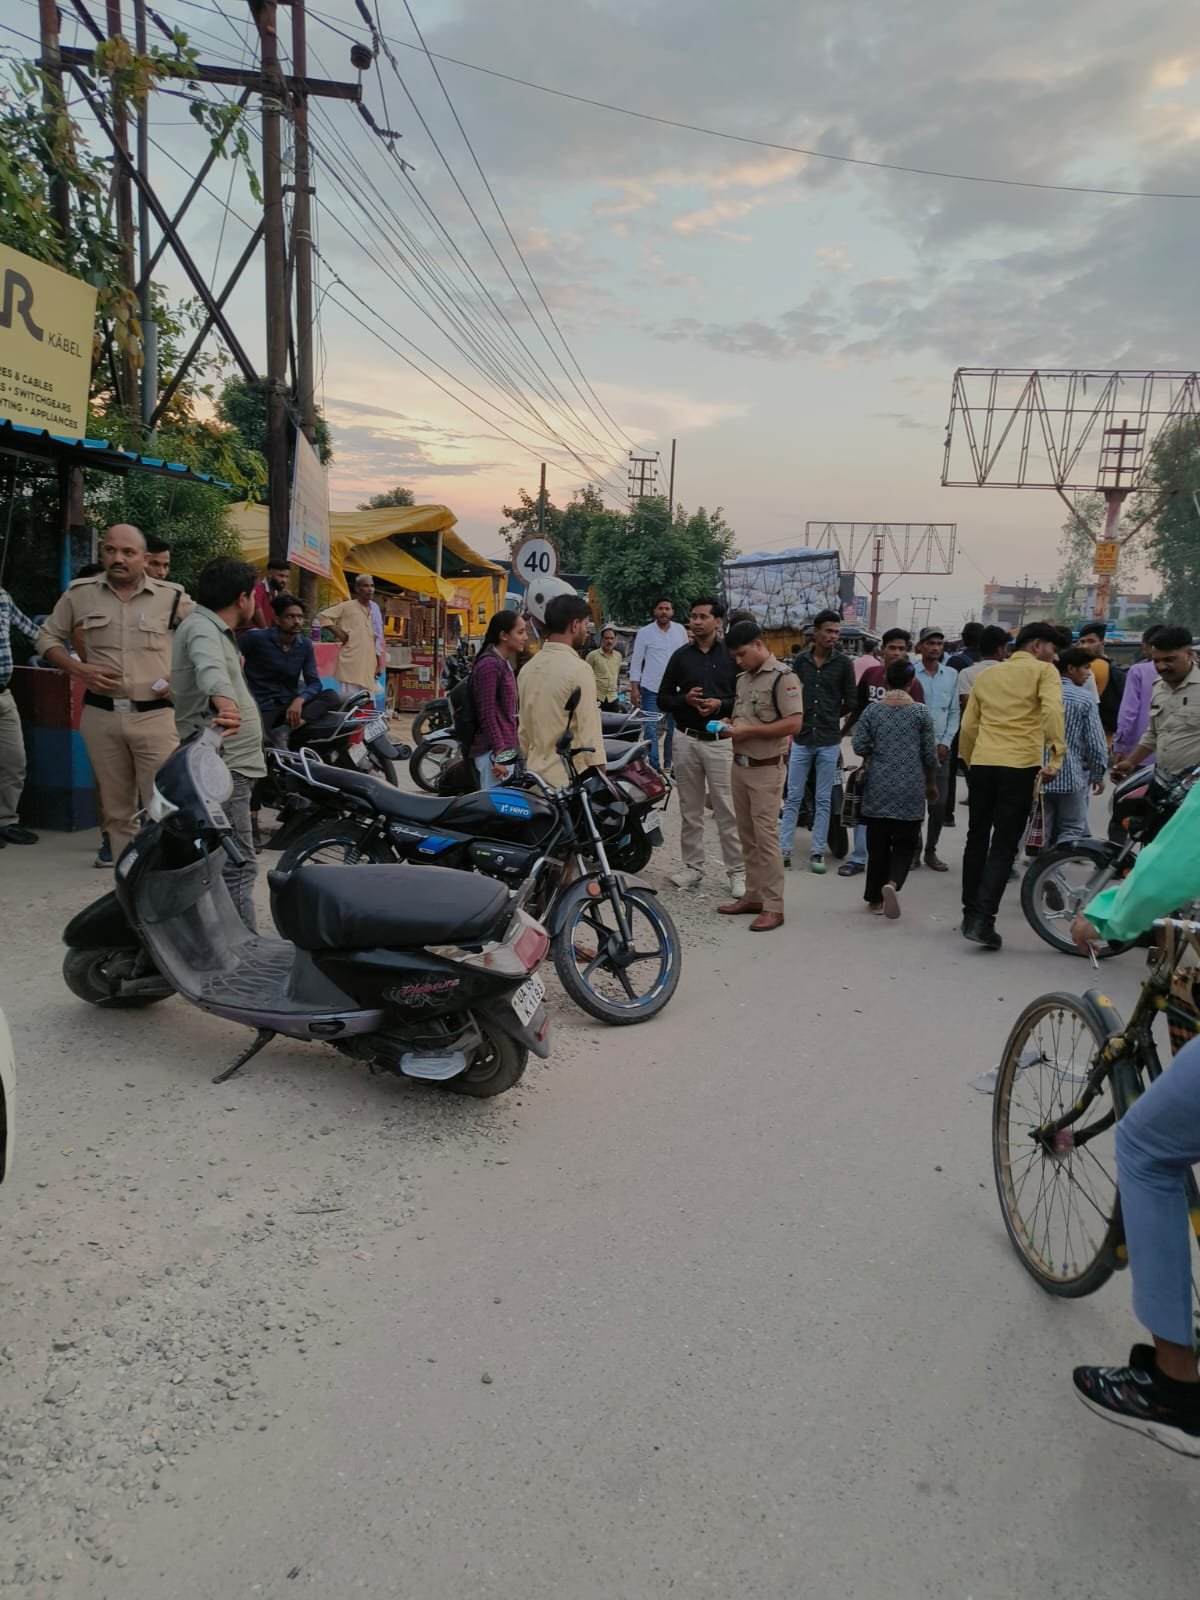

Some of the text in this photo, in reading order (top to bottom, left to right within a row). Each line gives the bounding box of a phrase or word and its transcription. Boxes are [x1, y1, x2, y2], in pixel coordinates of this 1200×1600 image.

[22, 374, 53, 392] CABLES
[14, 387, 71, 413] SWITCHGEARS
[30, 408, 78, 429] APPLIANCES
[524, 551, 550, 573] 40
